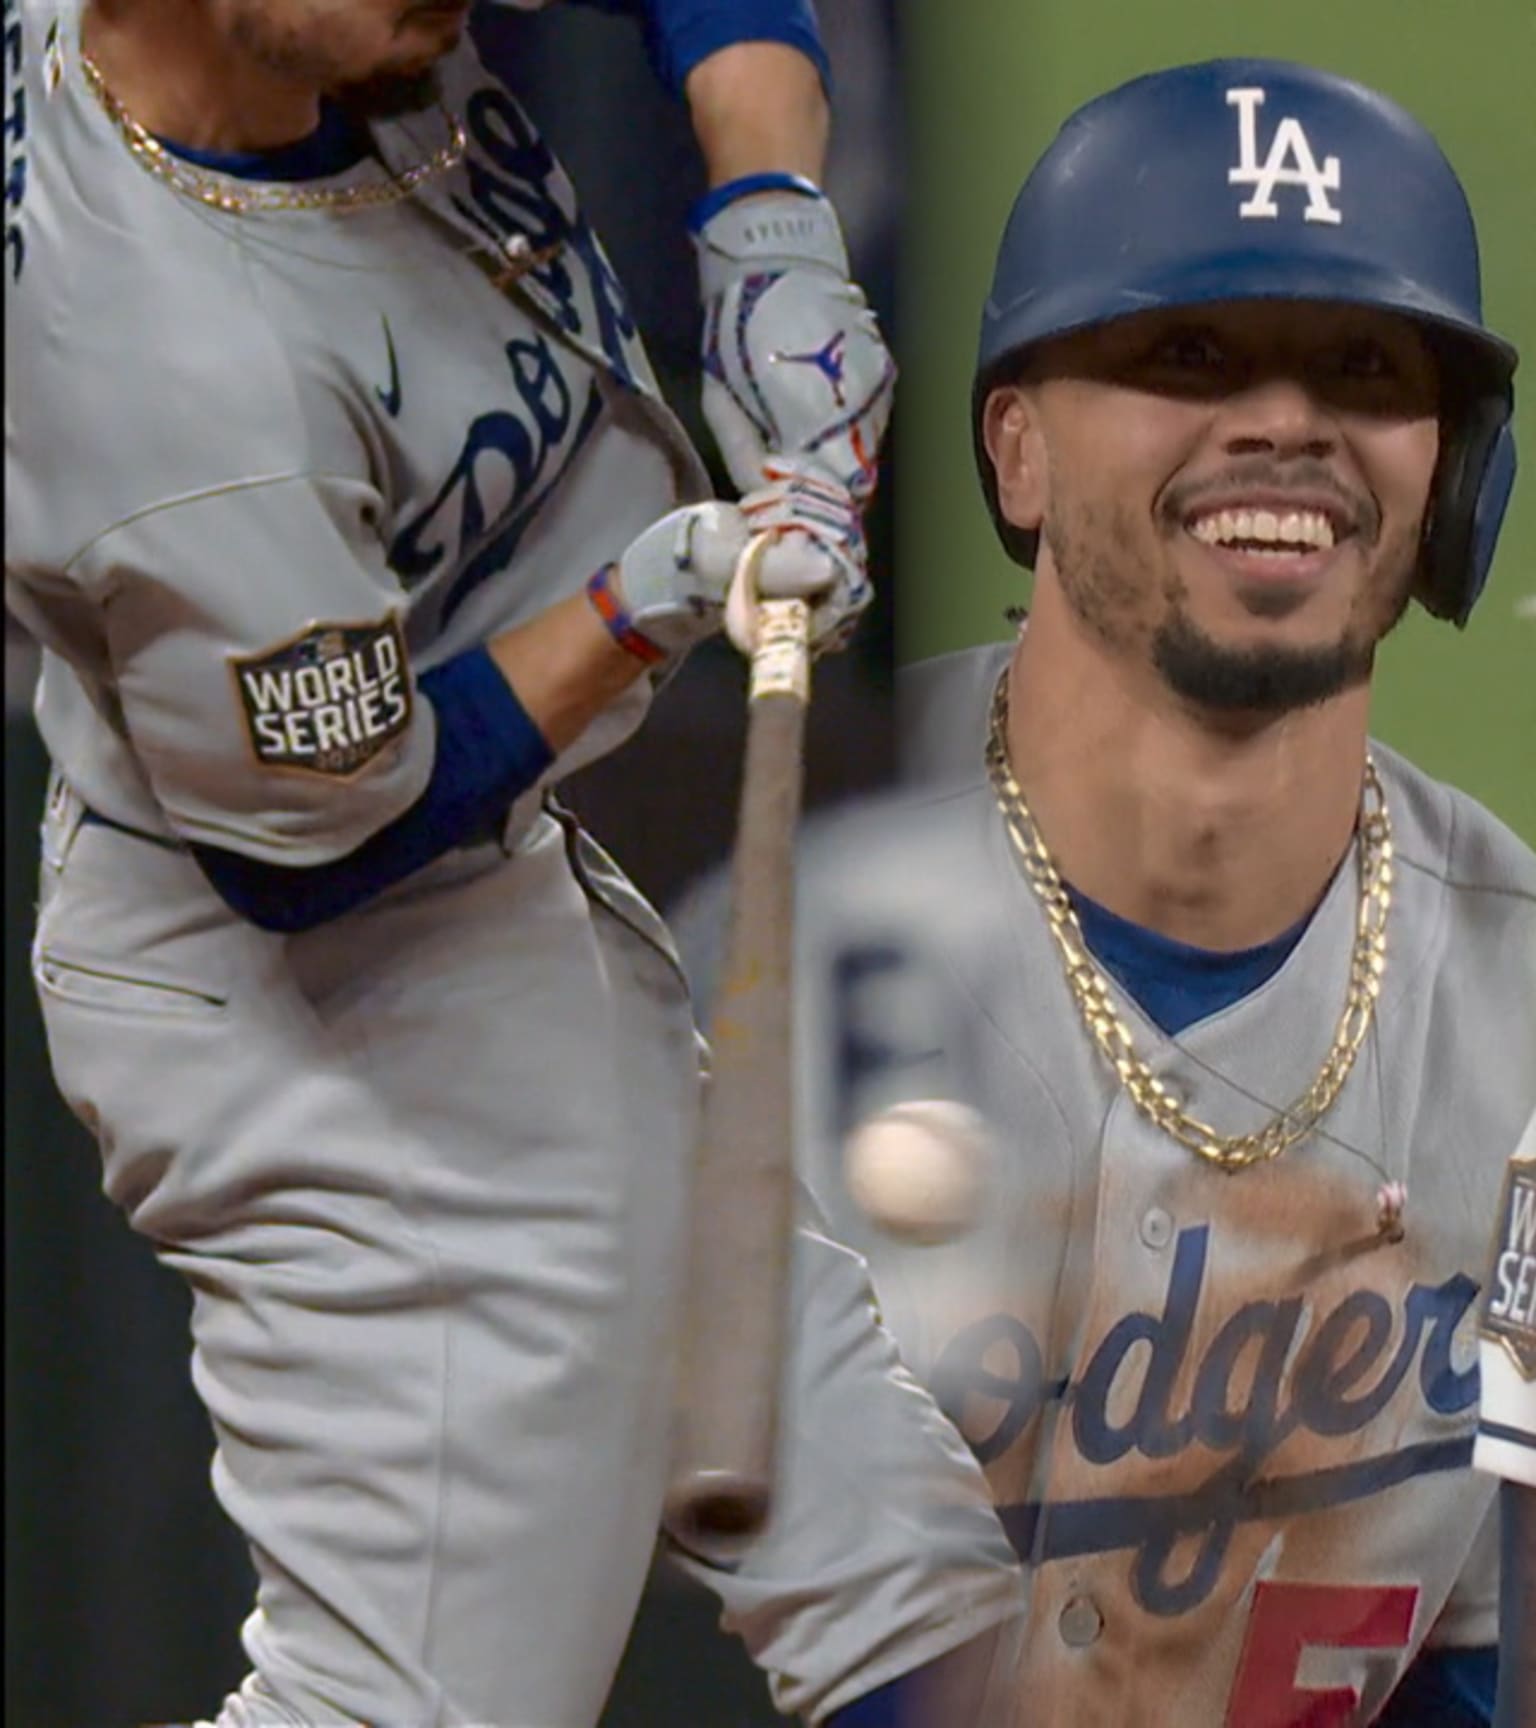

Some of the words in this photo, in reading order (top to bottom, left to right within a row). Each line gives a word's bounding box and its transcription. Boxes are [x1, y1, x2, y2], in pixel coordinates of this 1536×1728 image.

[1225, 87, 1342, 224] LA
[243, 634, 399, 711] WORLD
[255, 675, 406, 754] SERIES
